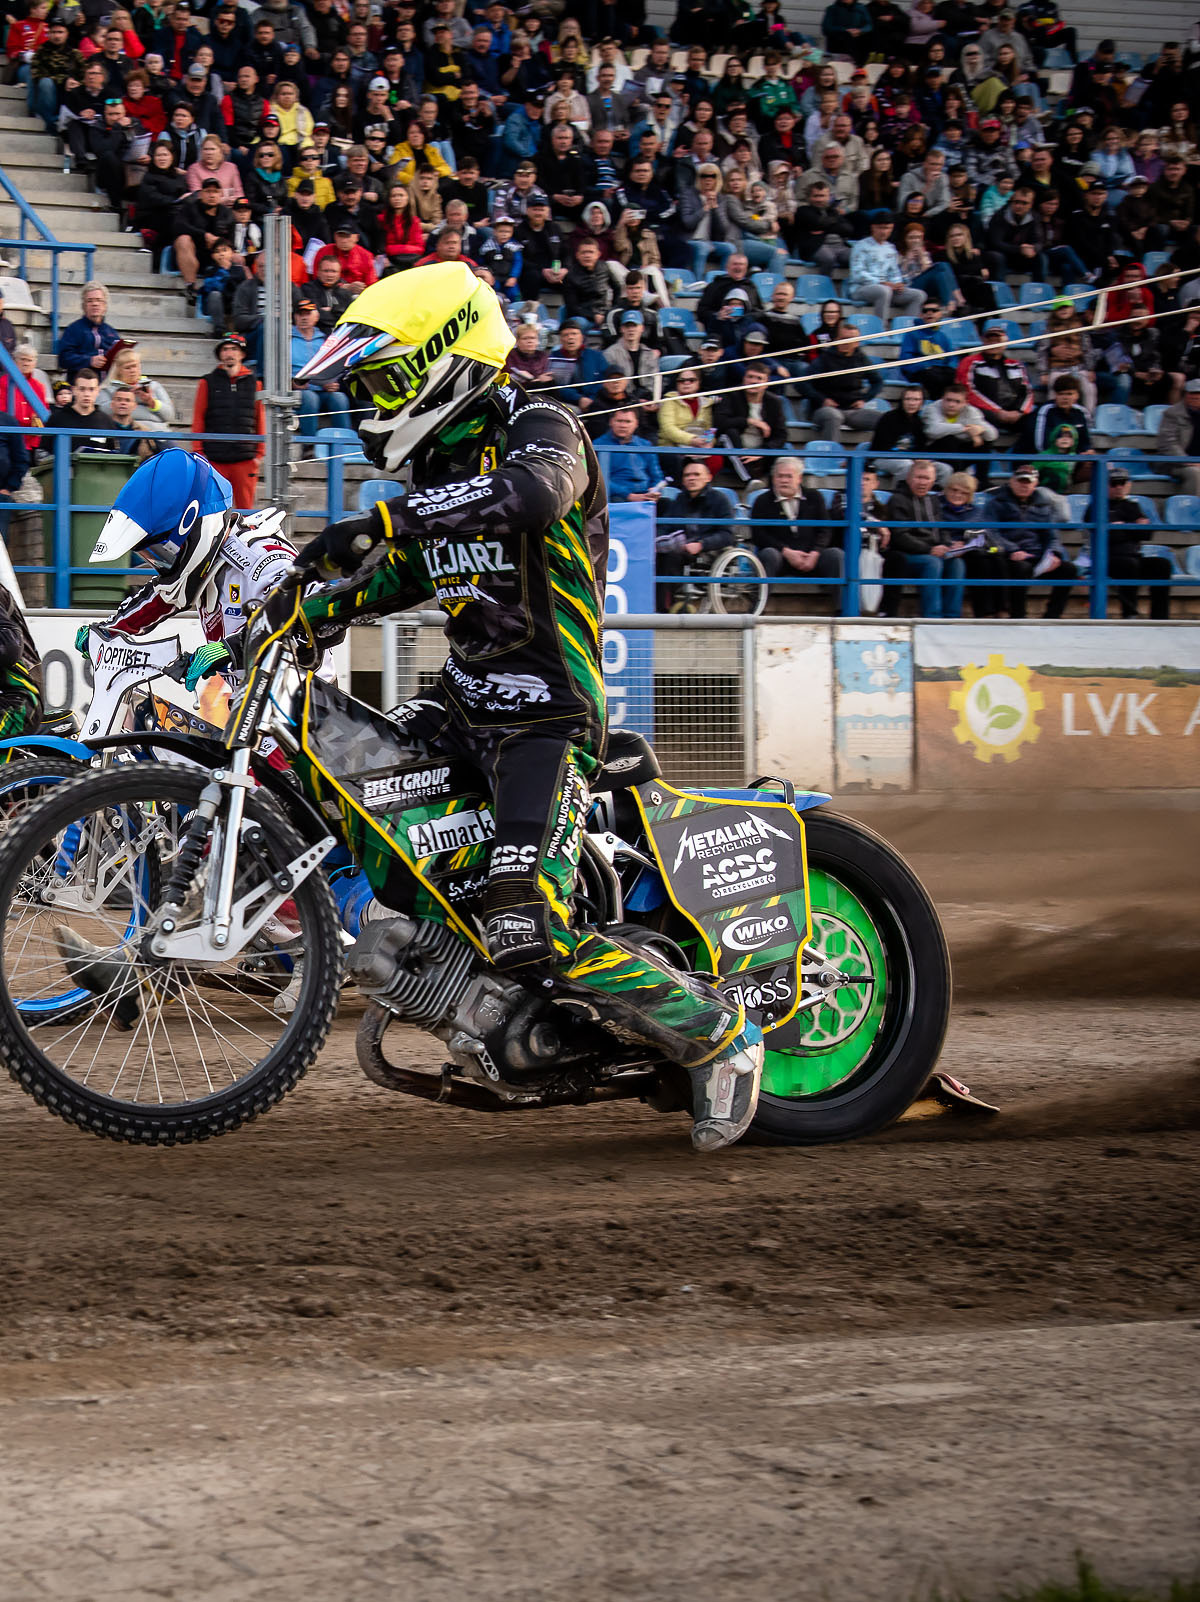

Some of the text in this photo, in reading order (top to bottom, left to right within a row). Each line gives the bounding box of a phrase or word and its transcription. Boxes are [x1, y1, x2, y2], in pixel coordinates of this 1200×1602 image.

[410, 300, 479, 373] 100%
[103, 646, 151, 670] OPTIBET
[1062, 692, 1160, 736] LVK
[402, 766, 451, 791] GROUP
[546, 825, 566, 859] FIRMA
[557, 763, 576, 827] BUDOWLANA
[410, 811, 496, 856] Almark
[673, 811, 794, 875] METALIKA
[697, 835, 762, 860] RECYCLING
[490, 844, 539, 868] CDC
[702, 848, 778, 890] ACDC
[722, 878, 766, 895] RECYCLING
[734, 915, 789, 941] WIKO
